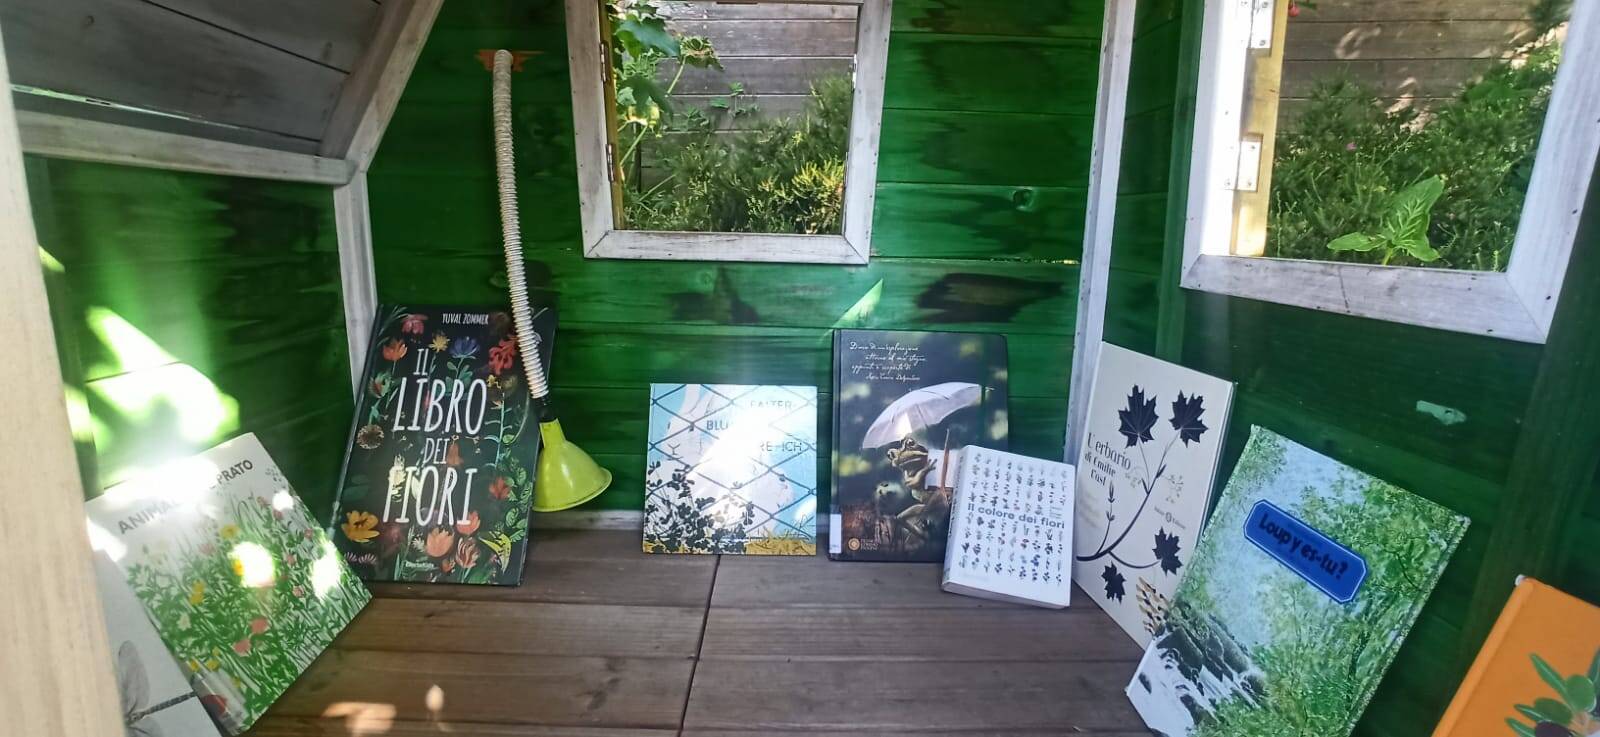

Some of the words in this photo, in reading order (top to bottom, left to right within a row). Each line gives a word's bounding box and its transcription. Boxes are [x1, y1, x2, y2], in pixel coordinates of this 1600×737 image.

[442, 313, 461, 325] YUVAL
[462, 313, 489, 326] ZOMMER
[413, 348, 429, 376] IL
[392, 377, 488, 435] LIBRO
[422, 437, 451, 465] DEI
[118, 498, 182, 535] ANIMAL
[216, 459, 254, 485] PRATO
[382, 465, 478, 527] FIORI
[978, 505, 1015, 520] colore
[1018, 512, 1037, 524] dei
[1041, 517, 1065, 529] fiori
[1258, 512, 1293, 545] Loup
[1289, 536, 1302, 553] y
